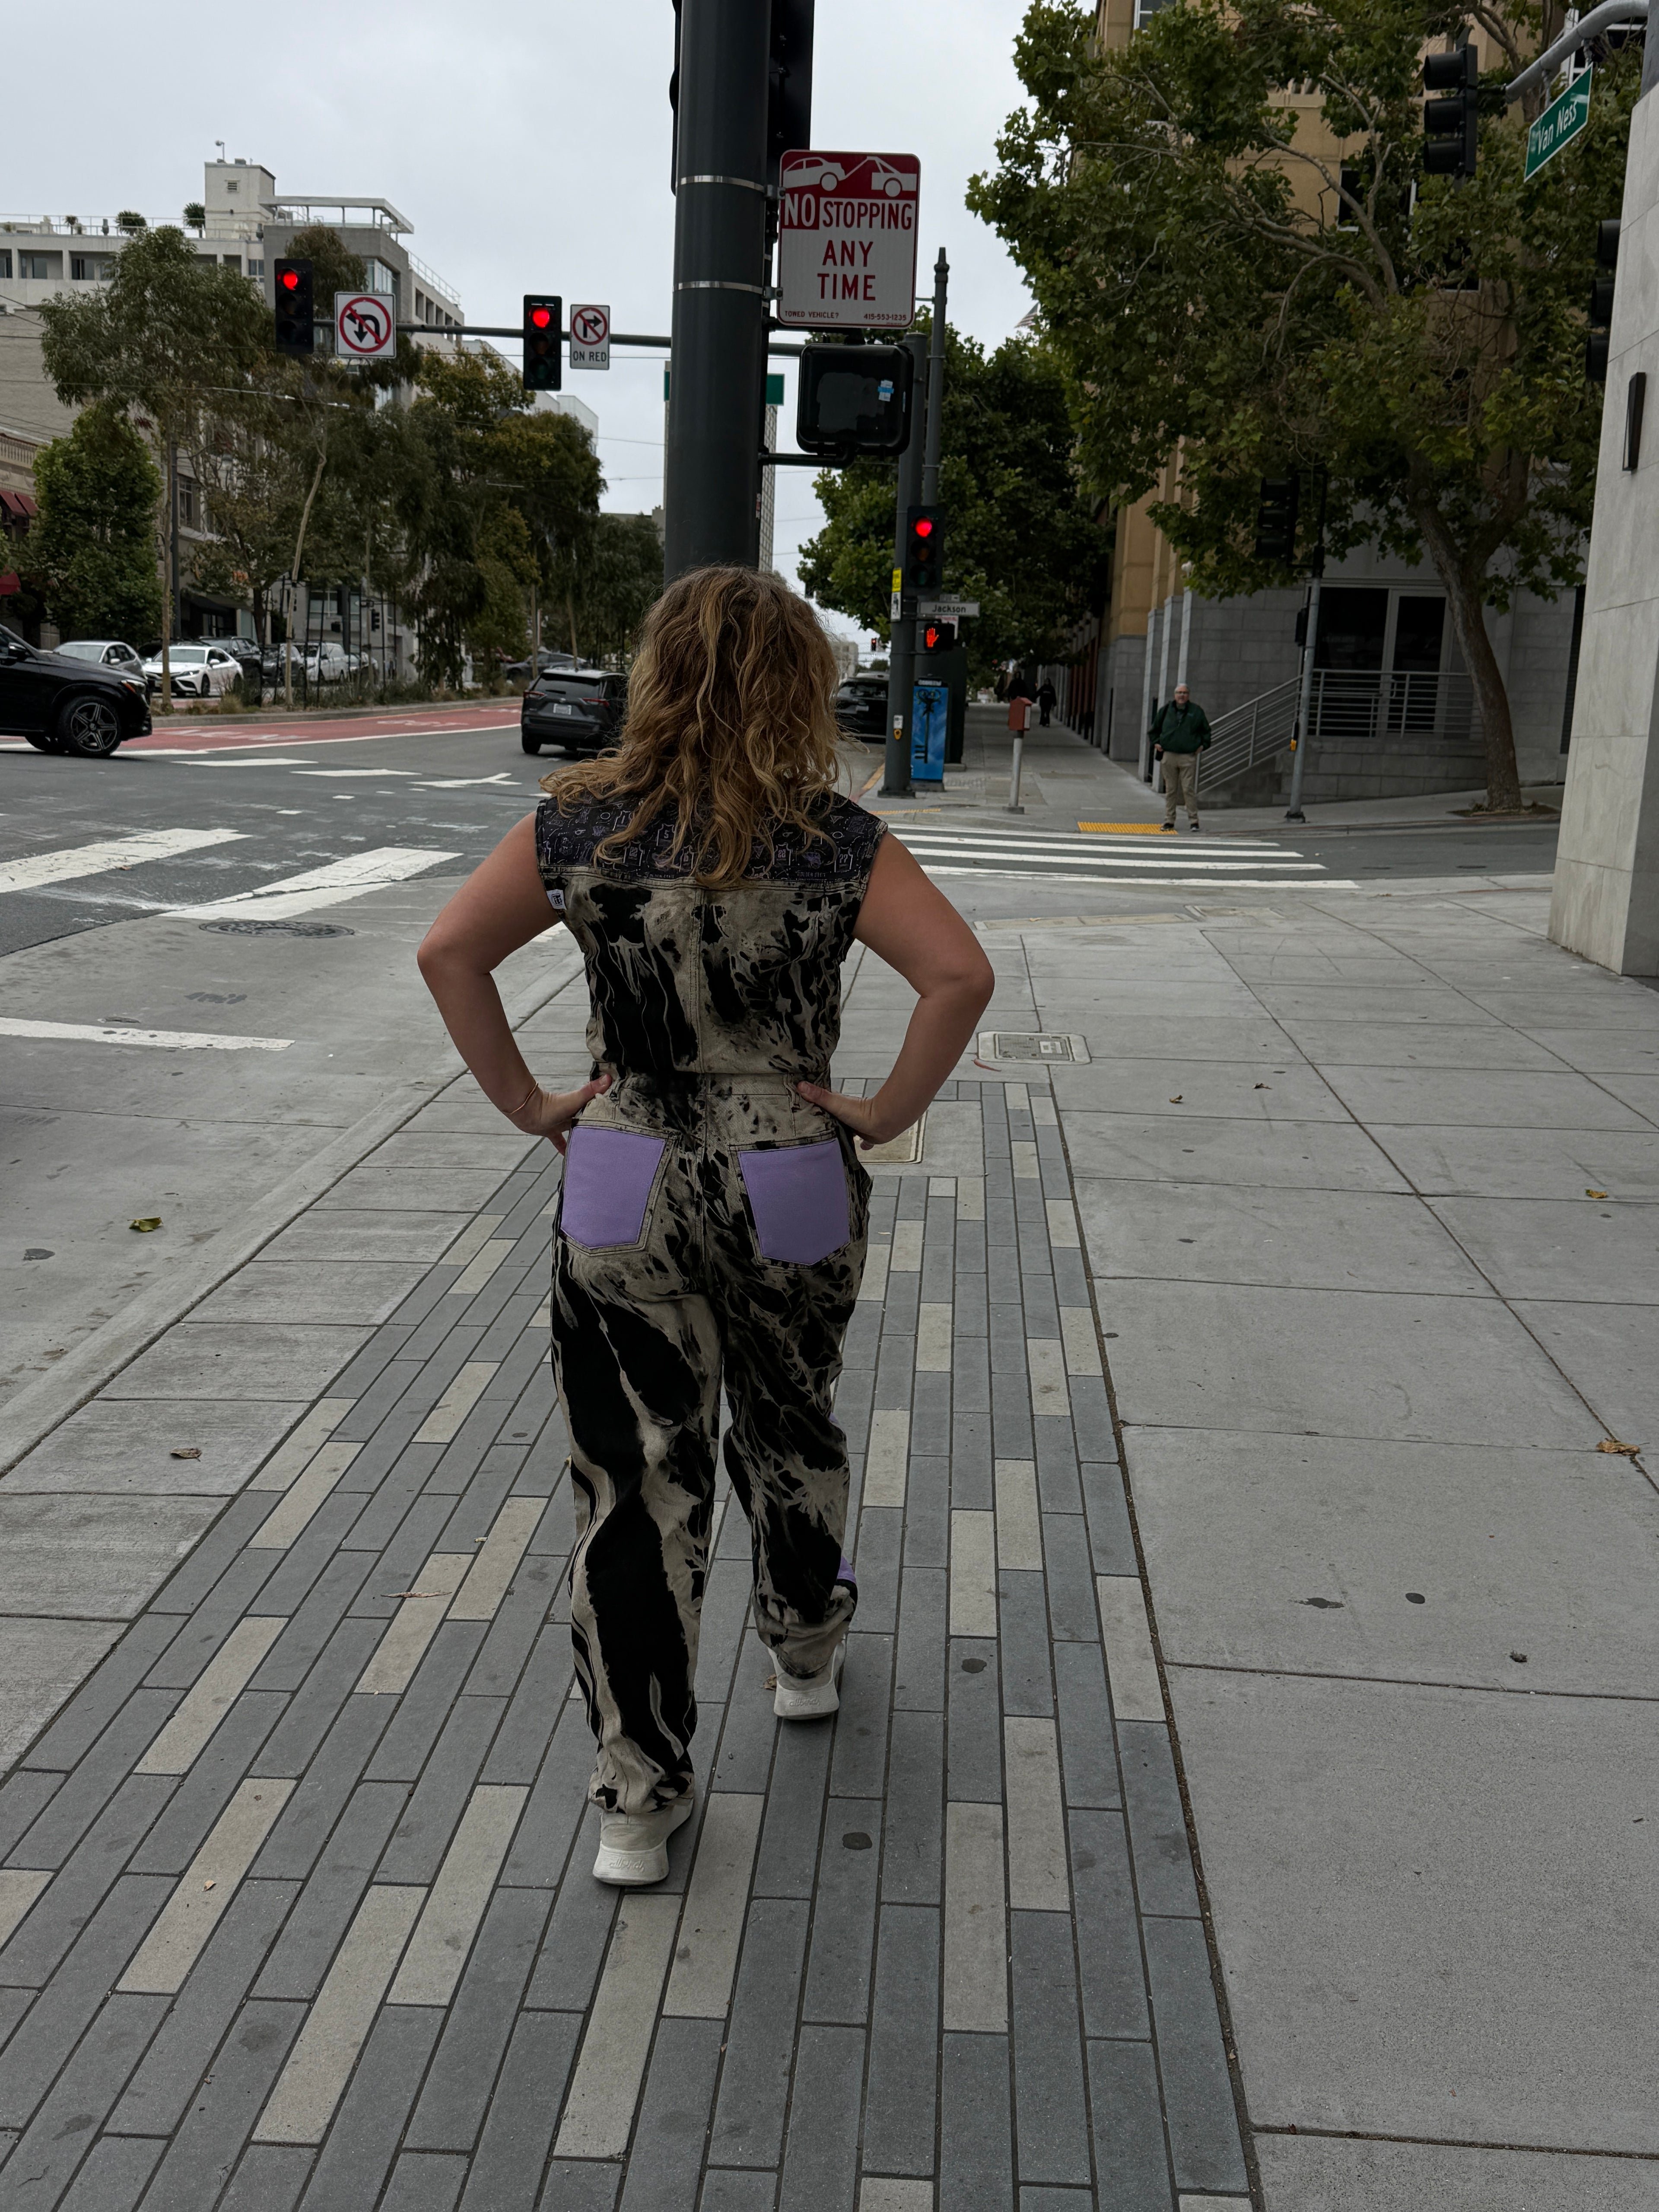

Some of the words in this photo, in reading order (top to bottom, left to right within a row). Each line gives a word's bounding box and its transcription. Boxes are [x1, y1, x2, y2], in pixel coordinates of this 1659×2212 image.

[1538, 124, 1554, 155] Van
[1556, 101, 1577, 138] Ness
[785, 193, 816, 227] NO
[823, 201, 912, 230] STOPPING
[822, 240, 873, 267] ANY
[817, 273, 876, 301] TIME
[573, 351, 585, 361] ON
[589, 352, 607, 362] RED
[932, 604, 966, 613] Jackson
[664, 830, 670, 839] 5
[629, 846, 638, 858] 22
[777, 849, 786, 858] 22
